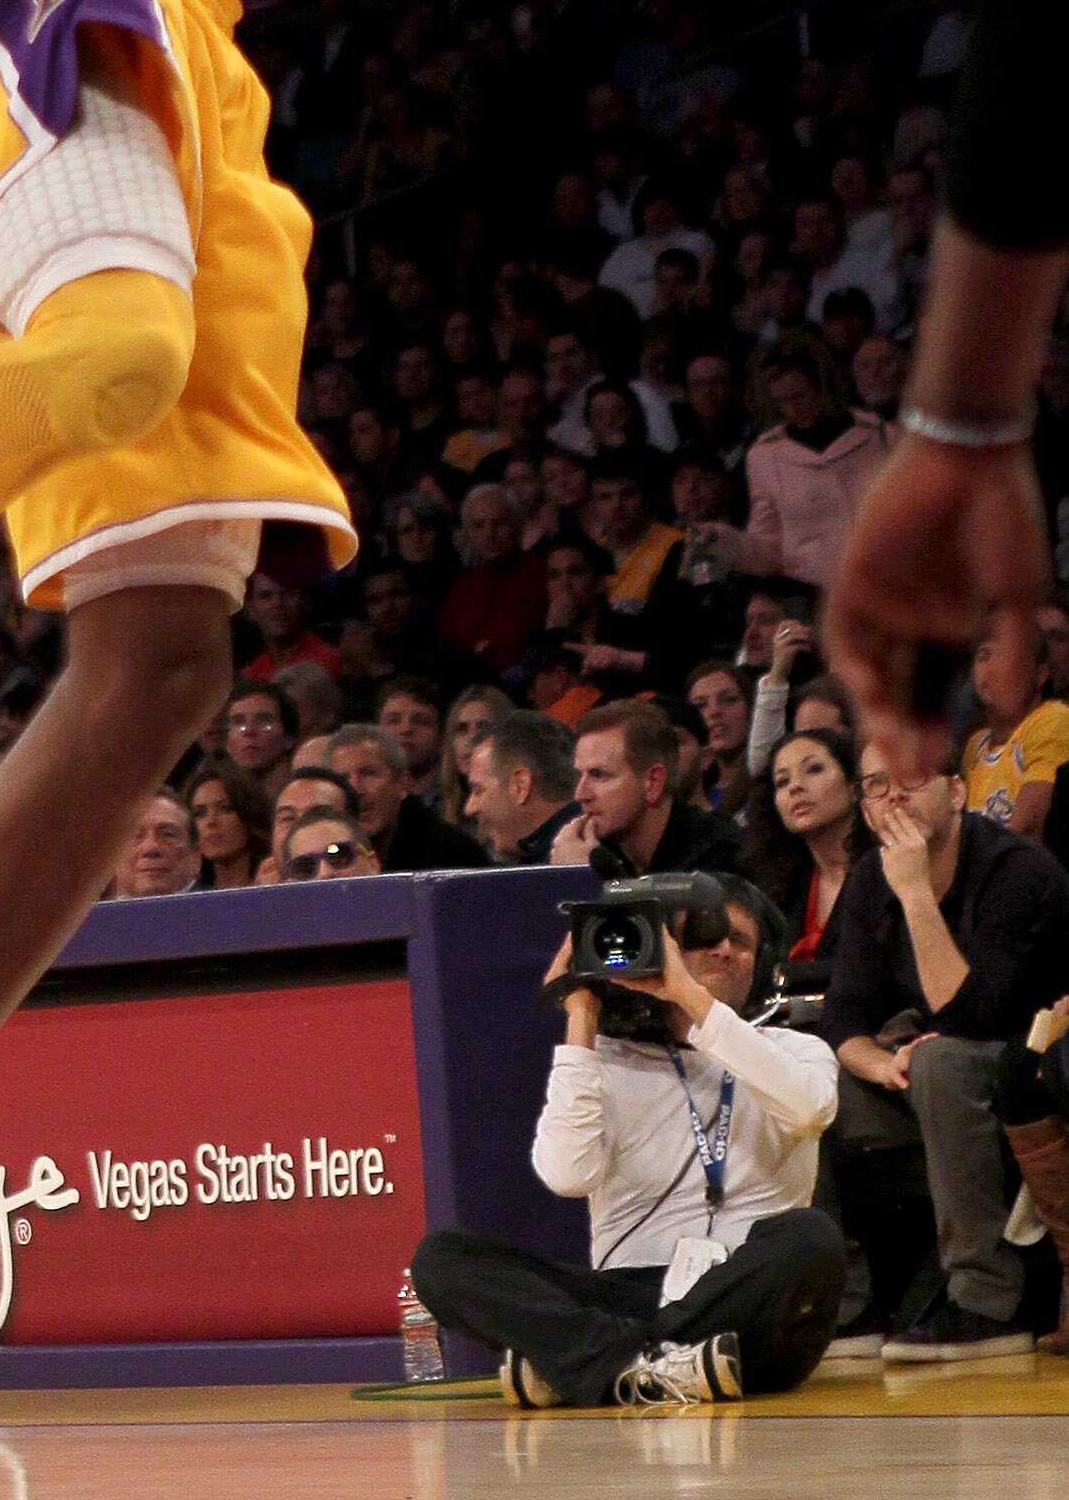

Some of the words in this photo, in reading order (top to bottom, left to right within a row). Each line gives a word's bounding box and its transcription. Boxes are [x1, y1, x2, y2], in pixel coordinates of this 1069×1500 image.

[88, 1150, 188, 1222] Vegas
[195, 1141, 296, 1205] Starts
[302, 1136, 395, 1196] Here.
